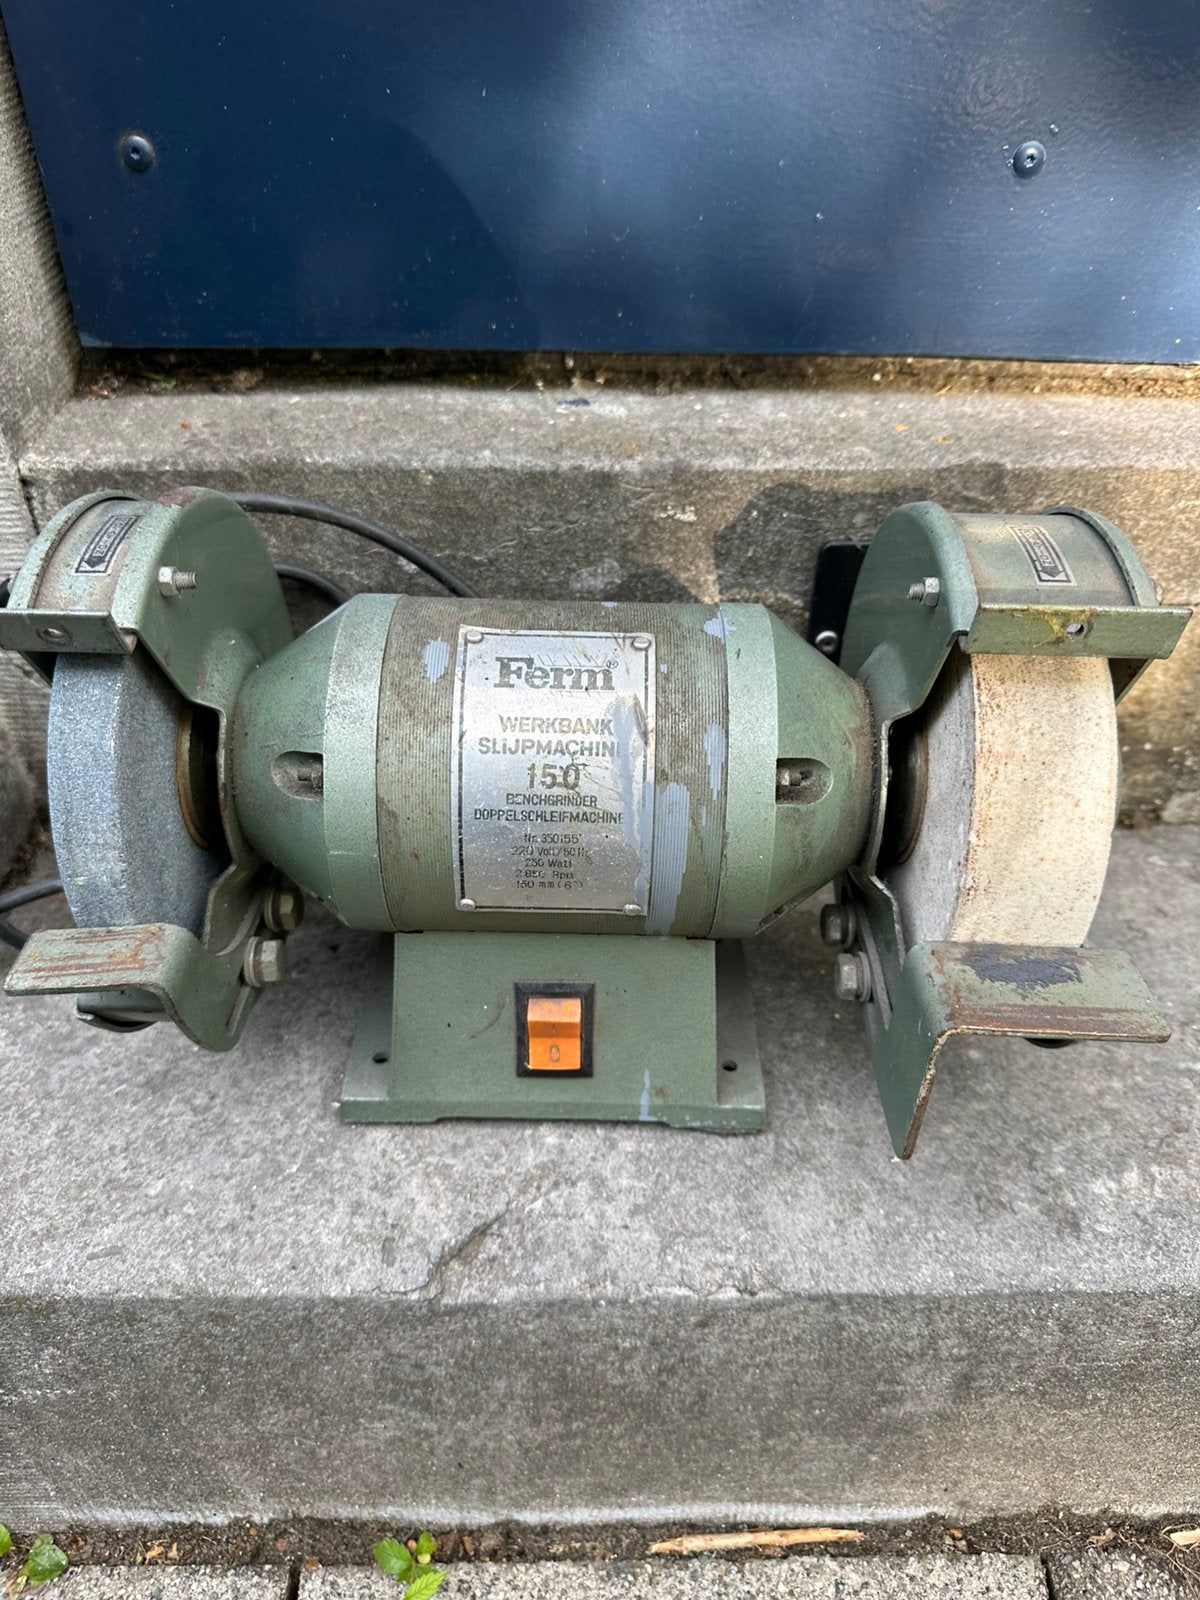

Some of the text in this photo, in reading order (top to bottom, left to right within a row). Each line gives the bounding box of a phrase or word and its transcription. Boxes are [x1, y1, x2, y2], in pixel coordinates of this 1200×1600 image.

[498, 715, 614, 736] WERKBANK
[478, 737, 622, 757] SLIJPMACHIN
[528, 763, 580, 790] 150
[506, 793, 598, 807] BENCHGRINDER
[516, 880, 534, 889] 150
